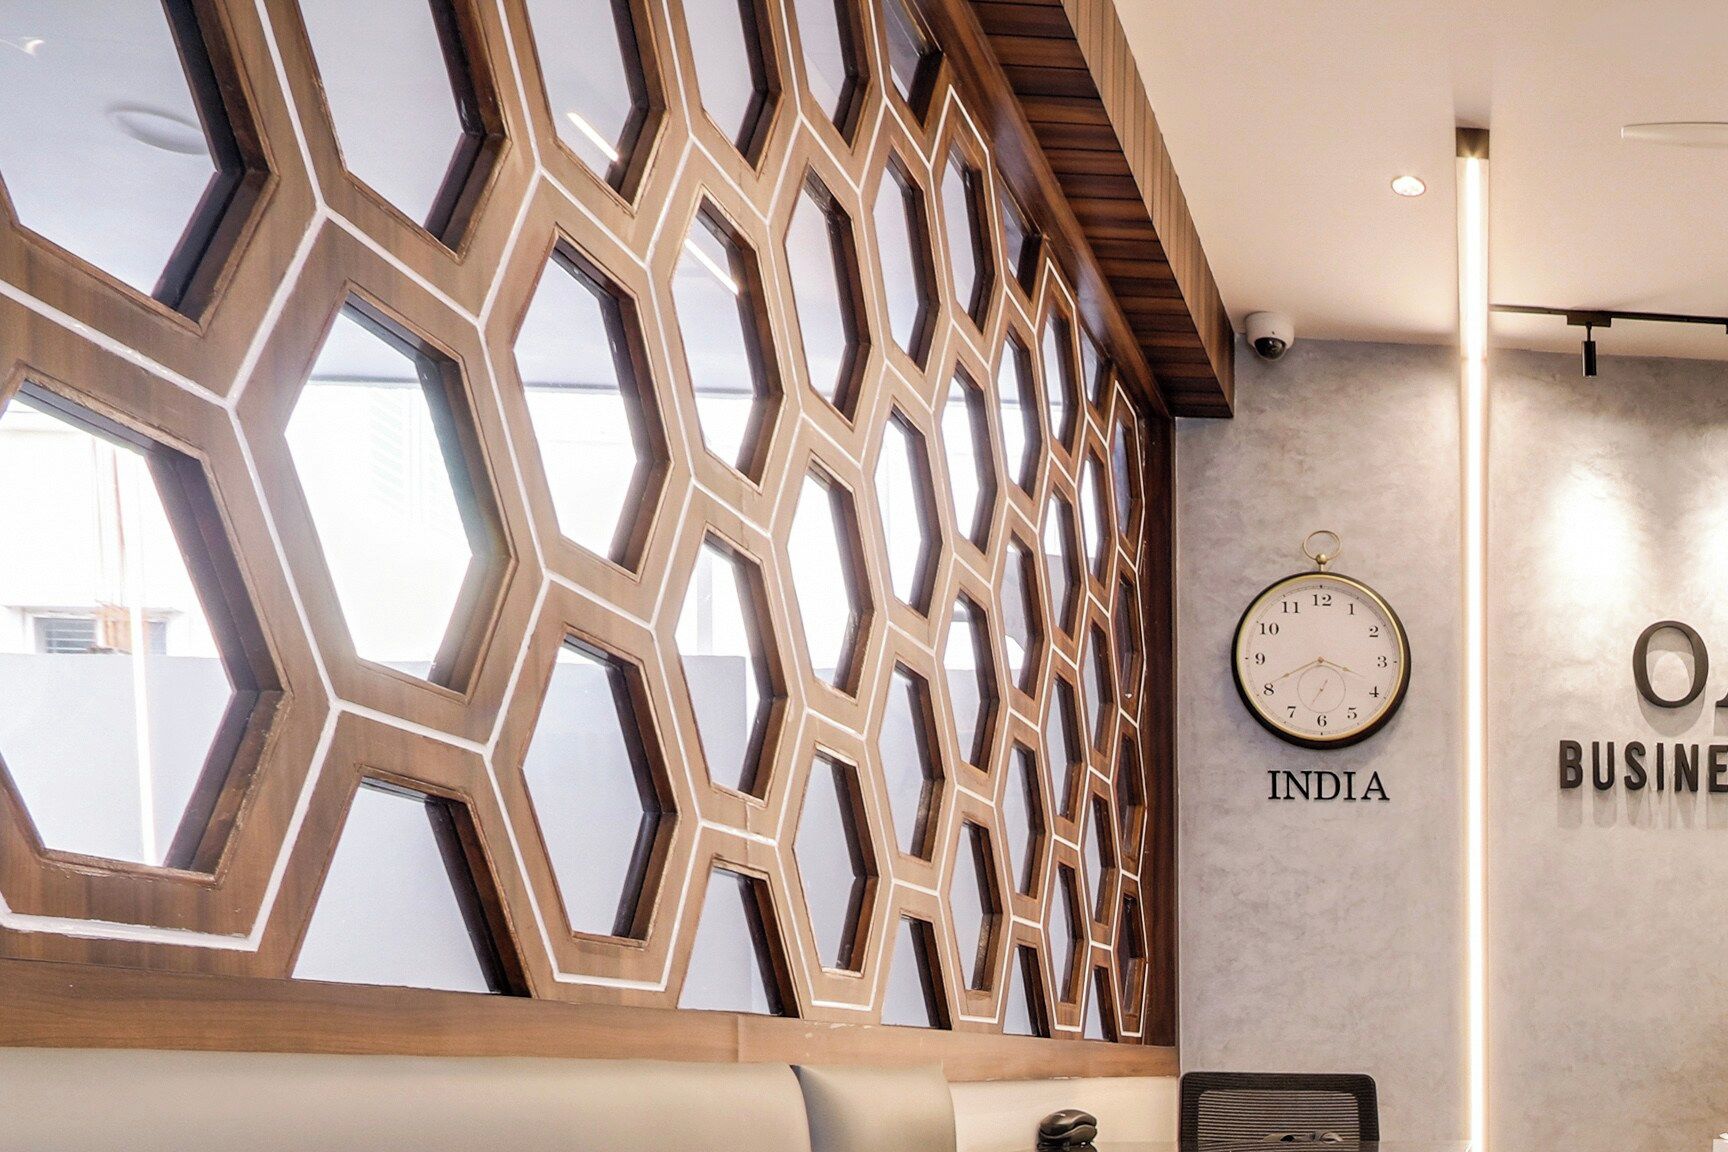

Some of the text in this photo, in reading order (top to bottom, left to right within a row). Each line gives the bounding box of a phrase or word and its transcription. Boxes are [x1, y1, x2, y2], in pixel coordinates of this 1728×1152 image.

[1312, 593, 1332, 607] 12
[1281, 601, 1300, 614] 11
[1348, 603, 1354, 615] 1
[1259, 623, 1279, 636] 10
[1368, 625, 1379, 638] 2
[1254, 652, 1266, 666] 9
[1376, 655, 1388, 669] 3
[1262, 682, 1275, 697] 8
[1368, 685, 1380, 698] 4
[1286, 705, 1297, 718] 7
[1346, 706, 1358, 720] 5
[1316, 714, 1327, 728] 6
[1268, 770, 1390, 801] INDIA
